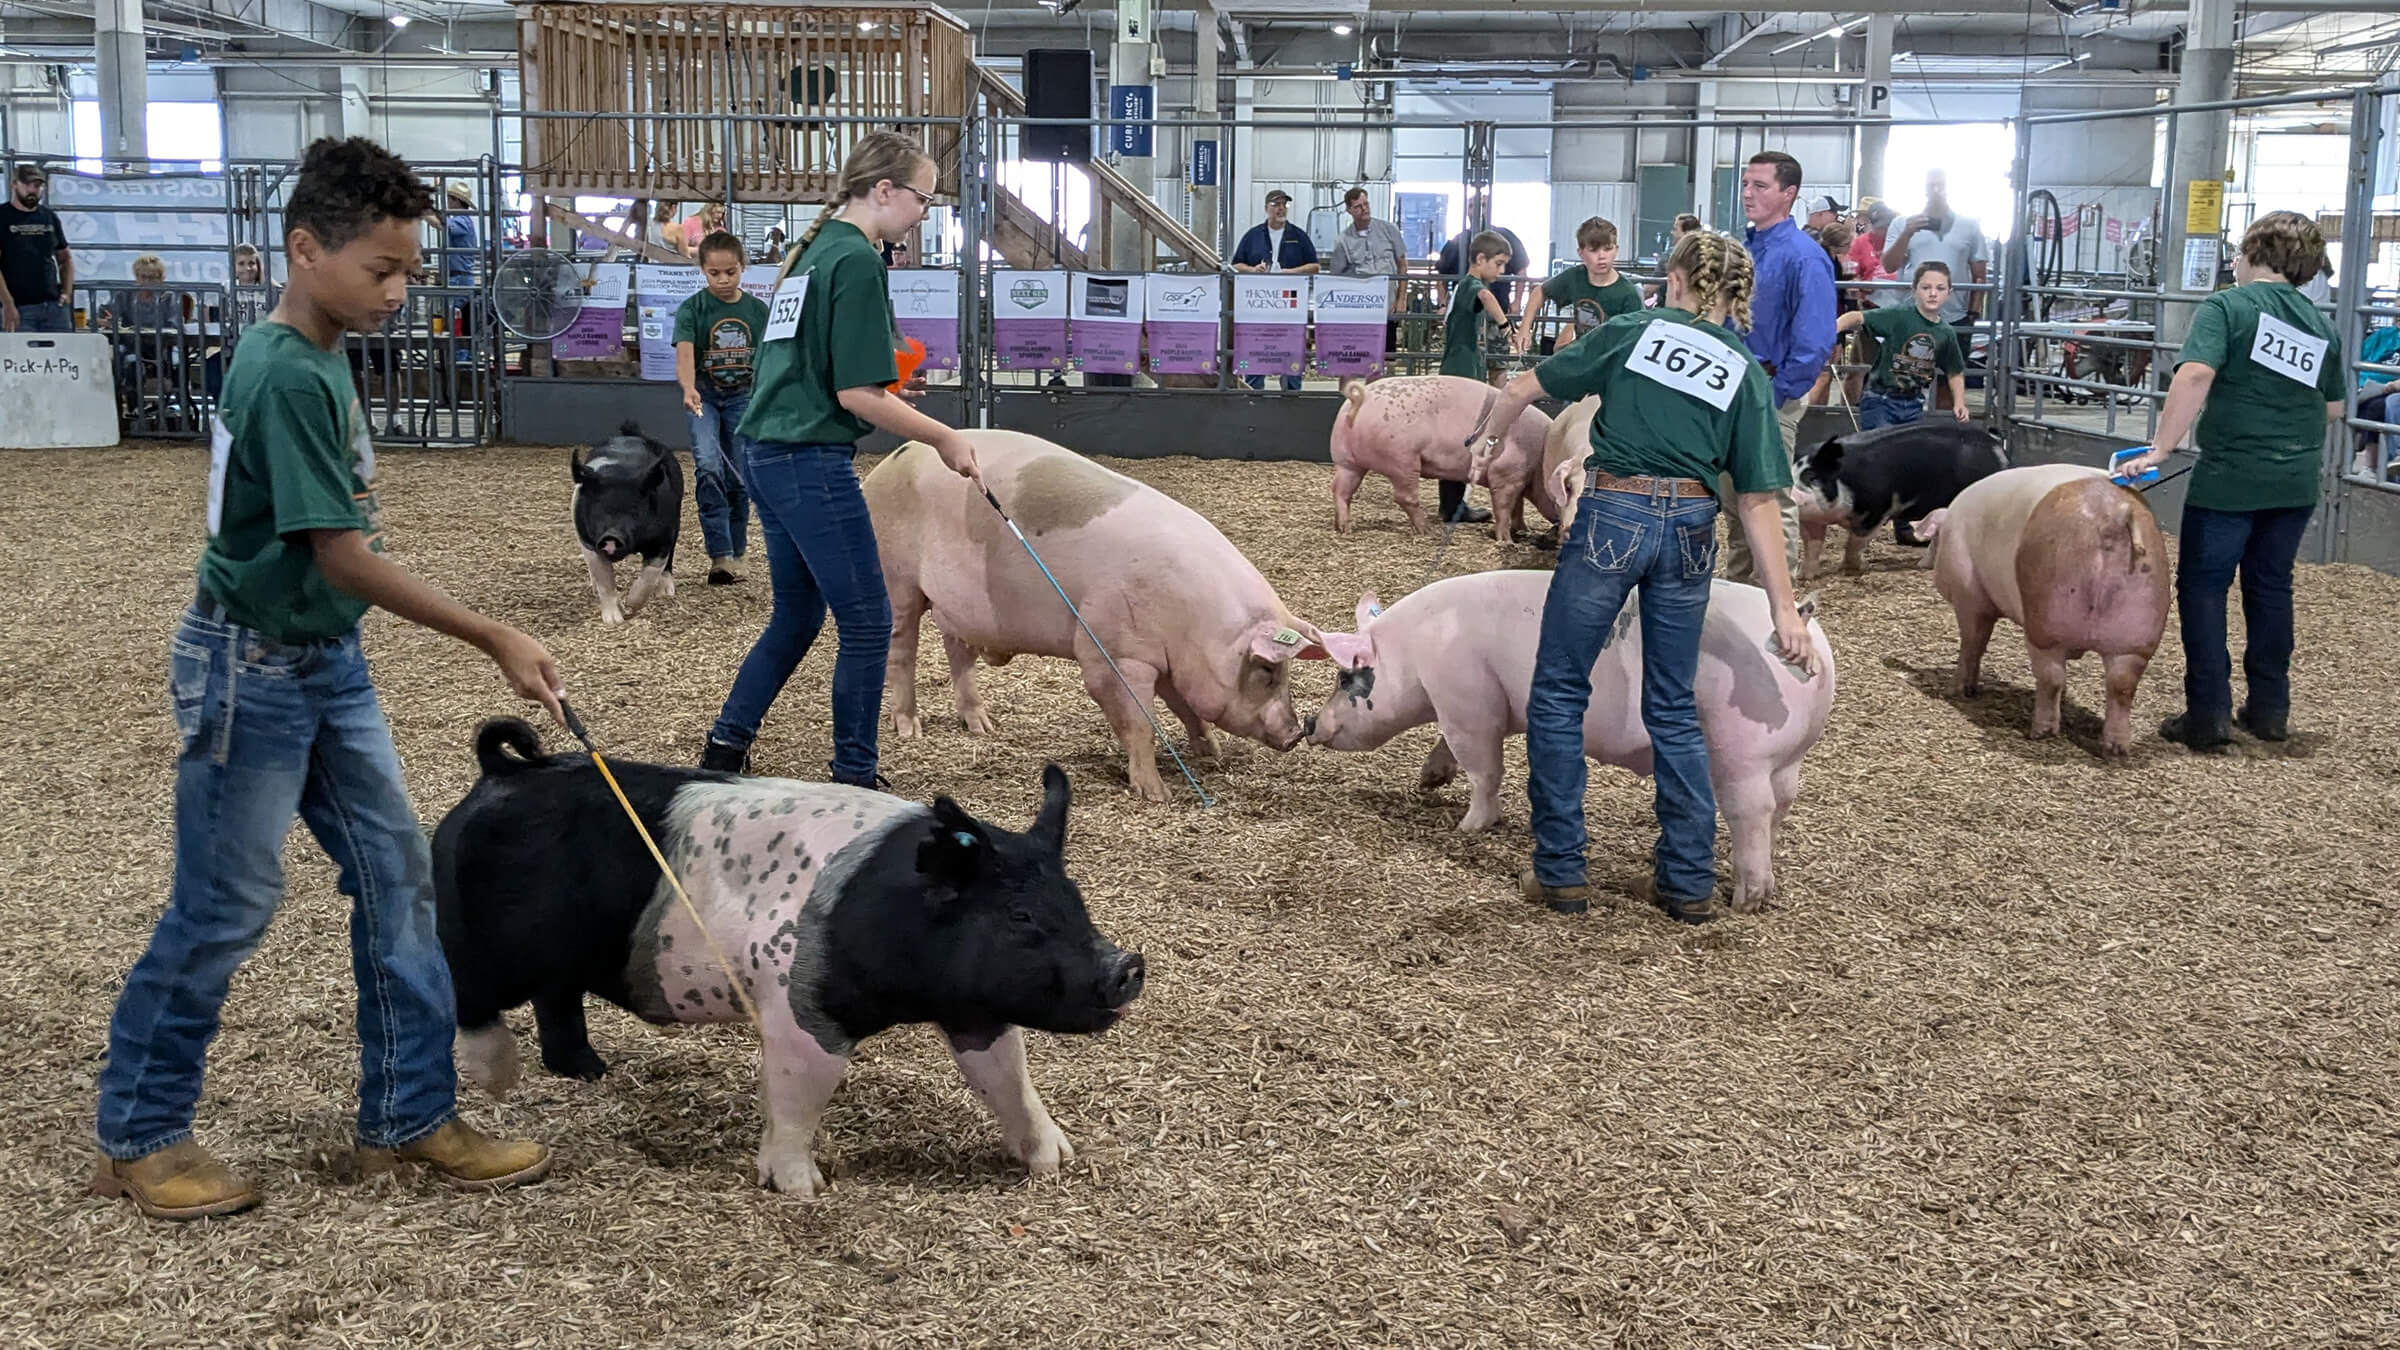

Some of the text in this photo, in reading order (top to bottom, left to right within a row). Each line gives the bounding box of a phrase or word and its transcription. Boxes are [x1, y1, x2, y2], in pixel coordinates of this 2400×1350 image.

[1871, 86, 1888, 110] P
[1012, 290, 1047, 298] NEXT GEN
[1247, 300, 1289, 309] AGENCY
[1250, 289, 1280, 299] HOME
[1318, 289, 1386, 309] ANDERSON
[2260, 332, 2315, 372] 2116
[4, 358, 79, 380] Pick-A-Pig
[1644, 339, 1730, 391] 1673
